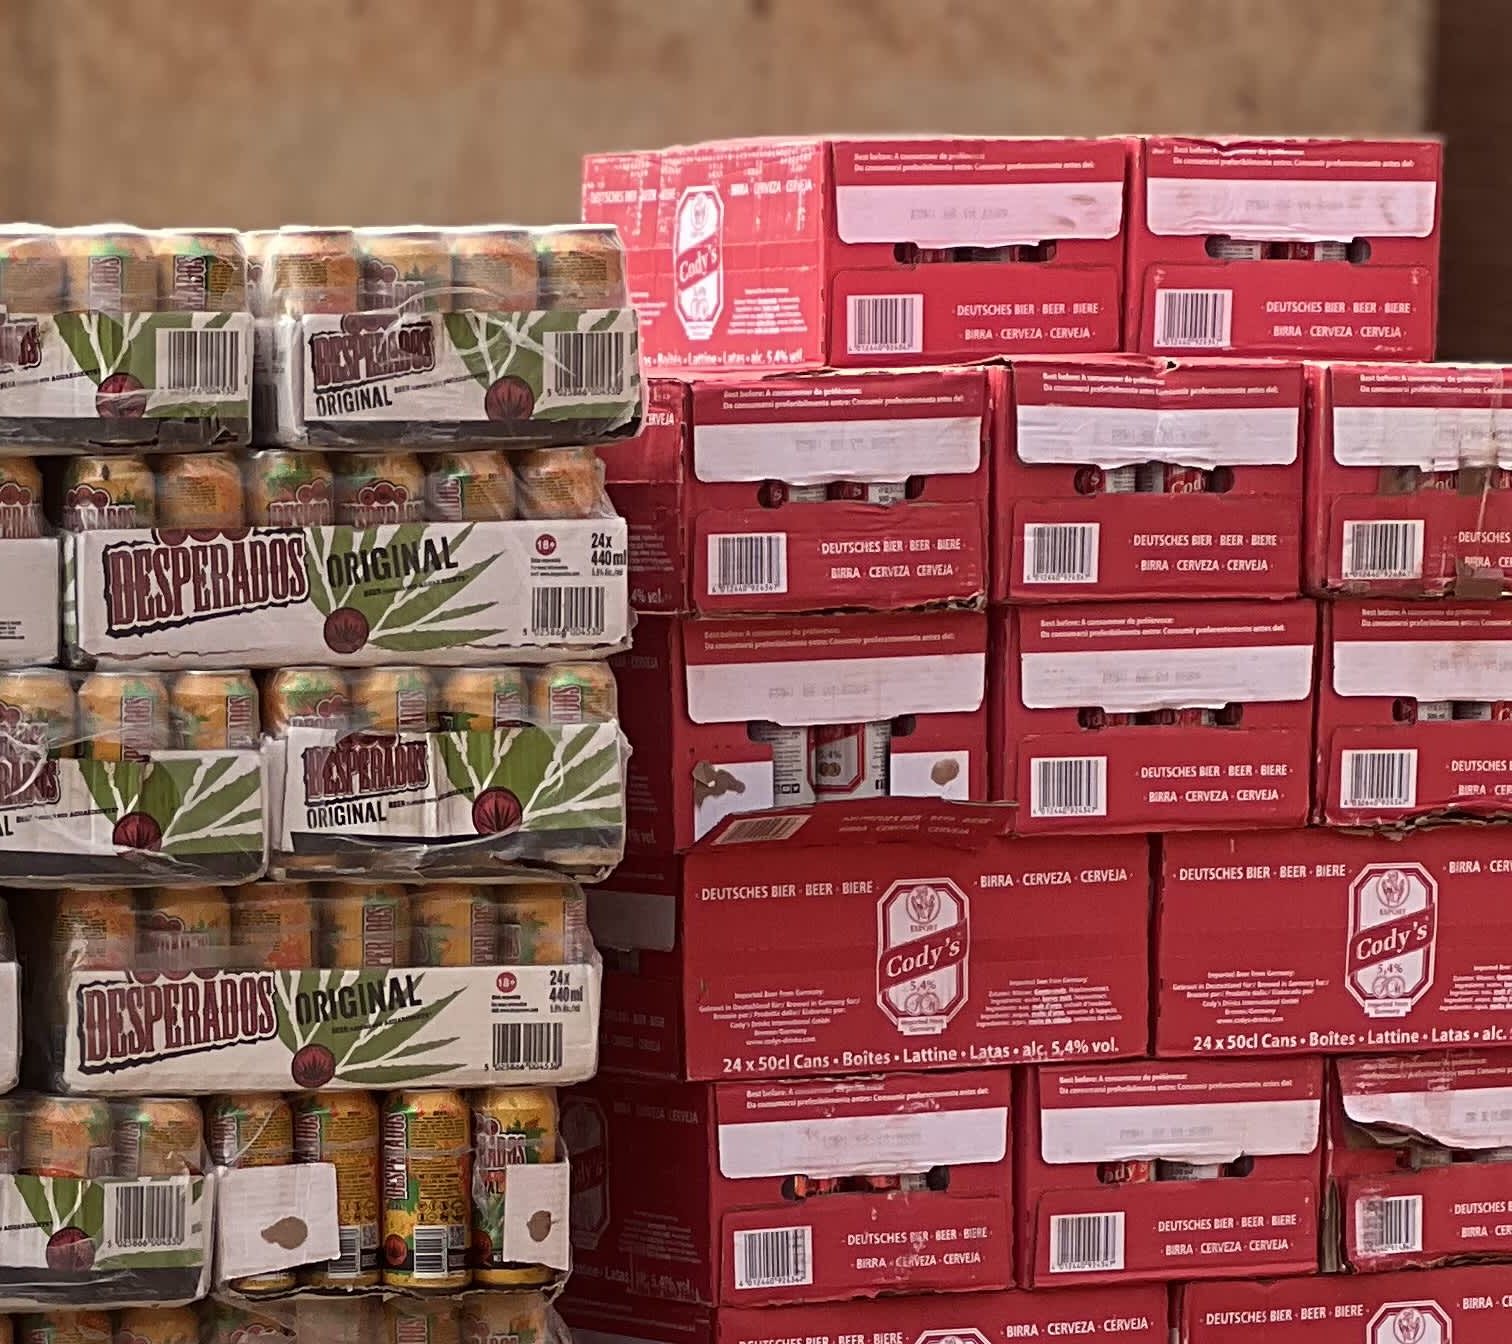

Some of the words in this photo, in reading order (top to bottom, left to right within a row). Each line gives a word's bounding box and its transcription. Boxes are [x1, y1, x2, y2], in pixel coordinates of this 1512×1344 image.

[956, 304, 1012, 316] DEUTSCHES
[1014, 303, 1034, 315] BIER
[1042, 303, 1065, 314] BEER
[1072, 303, 1098, 314] BIERE
[964, 329, 992, 340] BIRRA
[1000, 328, 1042, 339] CERVEZA
[1049, 327, 1090, 338] CERVEJA
[316, 384, 392, 416] ORIGINAL
[110, 538, 306, 625] DESPERADOS
[327, 537, 457, 588] ORIGINAL
[1140, 766, 1196, 778] DEUTSCHES
[1199, 765, 1220, 776] BIER
[1228, 765, 1252, 776] BEER
[1260, 764, 1287, 776] BIERE
[1148, 791, 1177, 802] BIRRA
[1185, 790, 1228, 802] CERVEZA
[1236, 789, 1278, 801] CERVEJA
[307, 800, 386, 828] ORIGINAL
[980, 874, 1014, 887] BIRRA
[1022, 871, 1072, 886] CERVEZA
[1080, 869, 1127, 882] CERVEJA
[702, 886, 768, 900] DEUTSCHES
[771, 884, 796, 897] BIER
[805, 882, 833, 896] BEER
[842, 881, 872, 894] BIERE
[1356, 922, 1428, 960] Cody's
[888, 939, 961, 978] Cody's
[87, 978, 275, 1061] DESPERADOS
[295, 974, 422, 1024] ORIGINAL
[723, 1058, 741, 1072] 24
[758, 1054, 789, 1070] 50cl
[793, 1054, 829, 1068] Cans
[842, 1050, 890, 1066] Boîtes
[903, 1047, 958, 1063] Lattine
[970, 1044, 1011, 1059] Latas
[1022, 1041, 1047, 1057] alc.
[1051, 1040, 1089, 1057] 5,4%
[1092, 1037, 1119, 1053] vol.
[1158, 1218, 1212, 1231] DEUTSCHES
[1214, 1217, 1234, 1229] BIER
[1241, 1216, 1264, 1227] BEER
[1271, 1214, 1296, 1226] BIERE
[1165, 1244, 1193, 1255] BIRRA
[1200, 1241, 1242, 1254] CERVEZA
[1249, 1239, 1288, 1251] CERVEJA
[1006, 1324, 1039, 1337] BIRRA
[1047, 1321, 1095, 1335] CERVEZA
[1103, 1317, 1148, 1331] CERVEJA
[873, 1332, 903, 1344] BIERE
